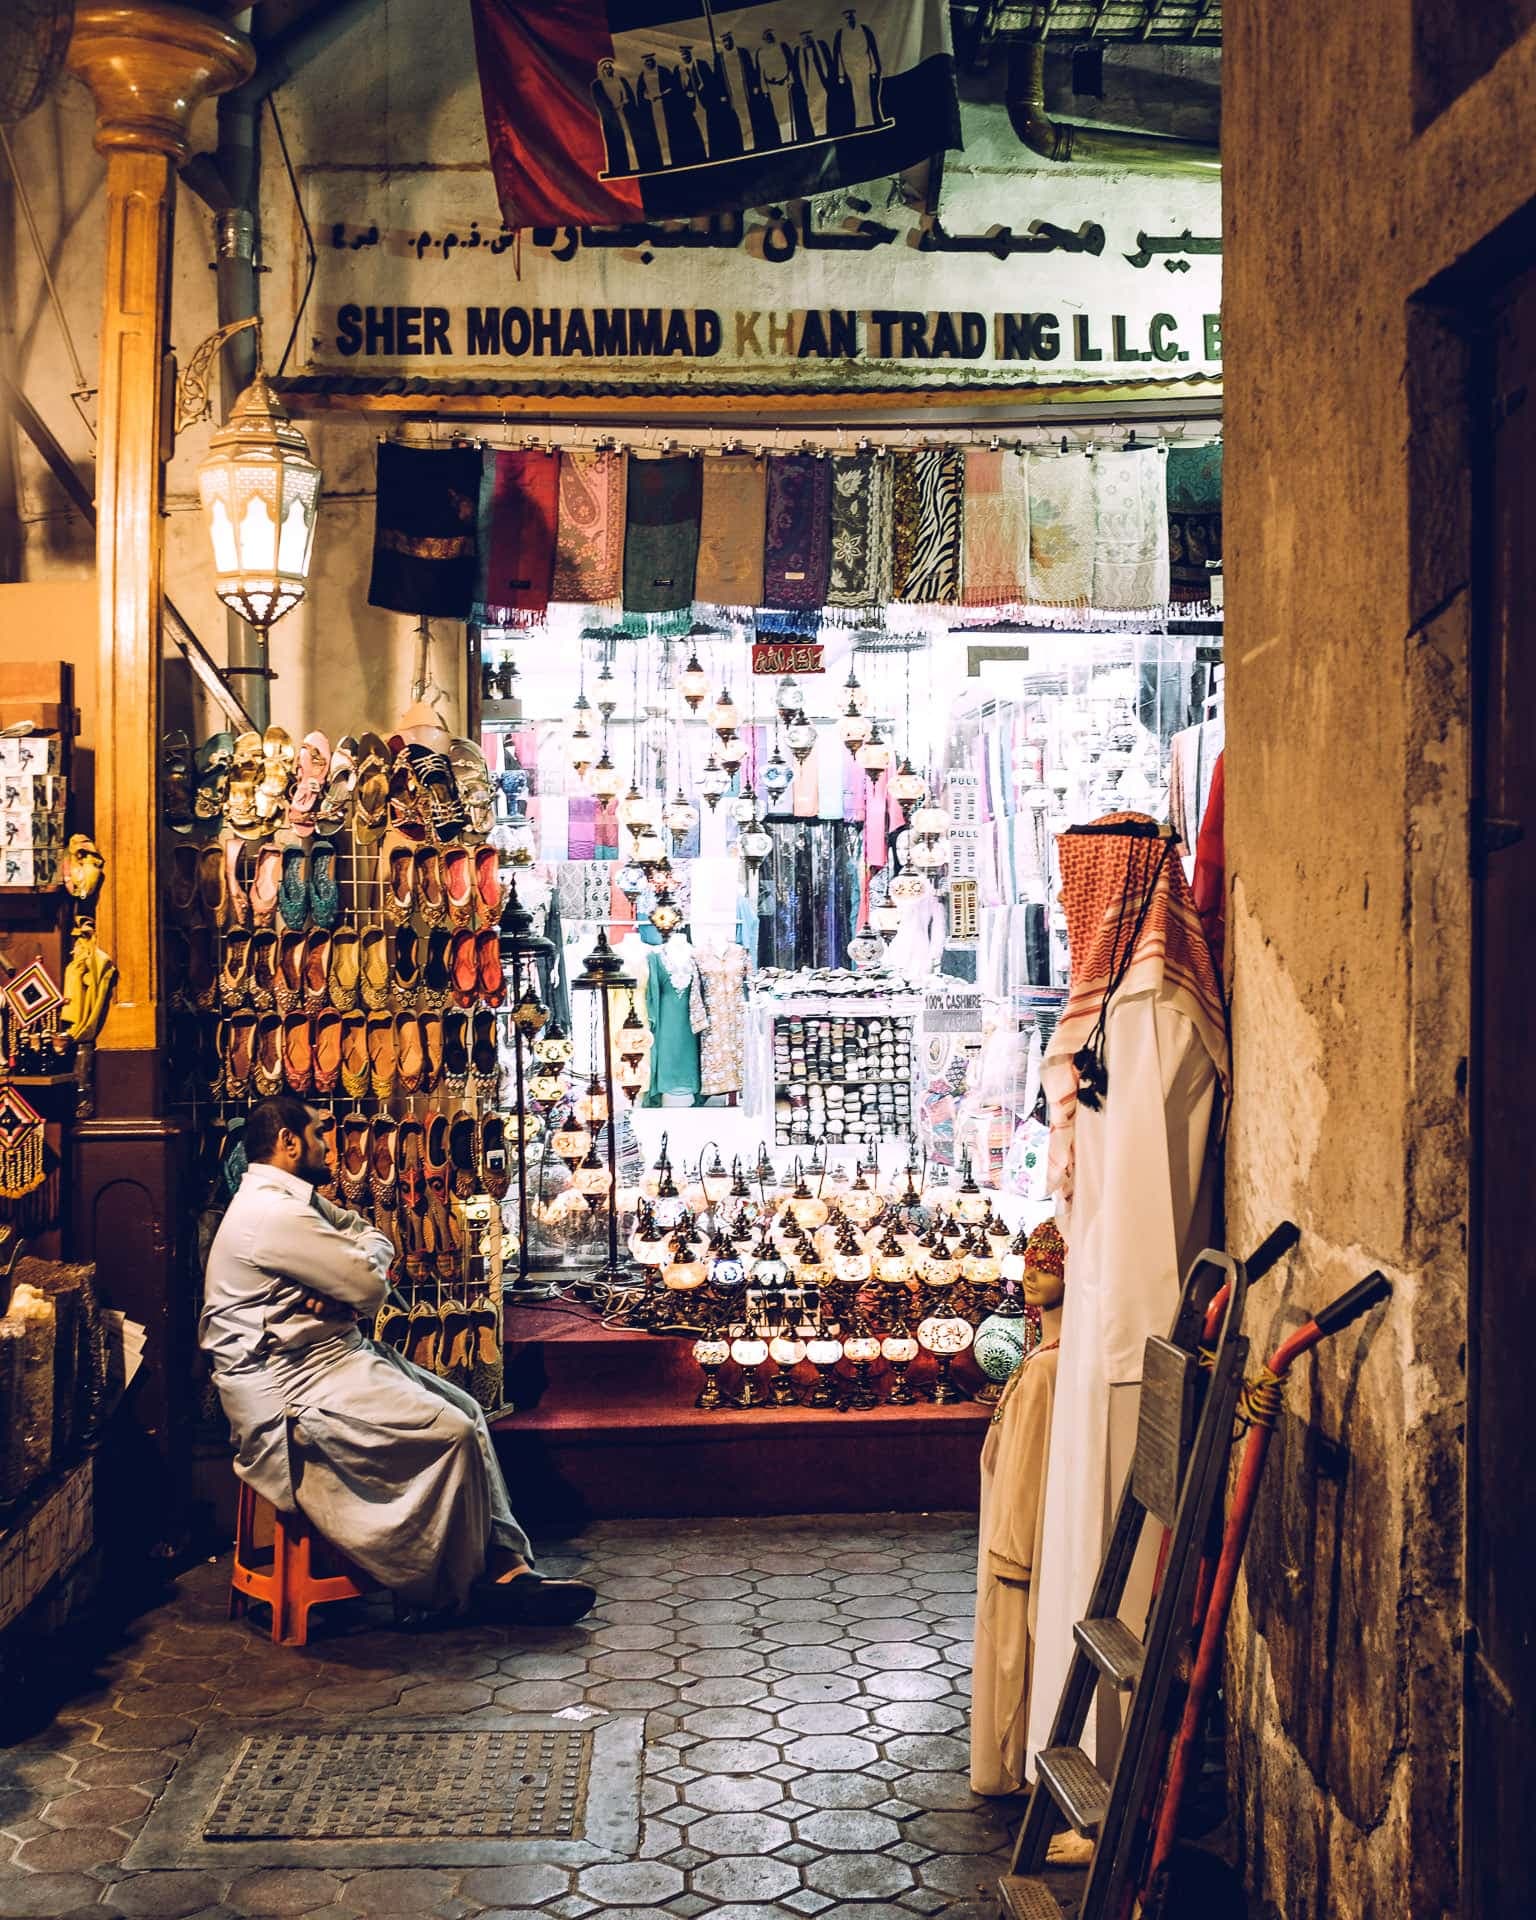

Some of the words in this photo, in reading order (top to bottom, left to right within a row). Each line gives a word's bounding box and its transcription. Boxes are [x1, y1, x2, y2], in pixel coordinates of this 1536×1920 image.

[336, 304, 453, 356] SHER
[466, 306, 721, 358] MOHAMMAD
[735, 309, 857, 358] KHAN
[872, 310, 1060, 362] TRADNG
[925, 994, 944, 1010] 100%
